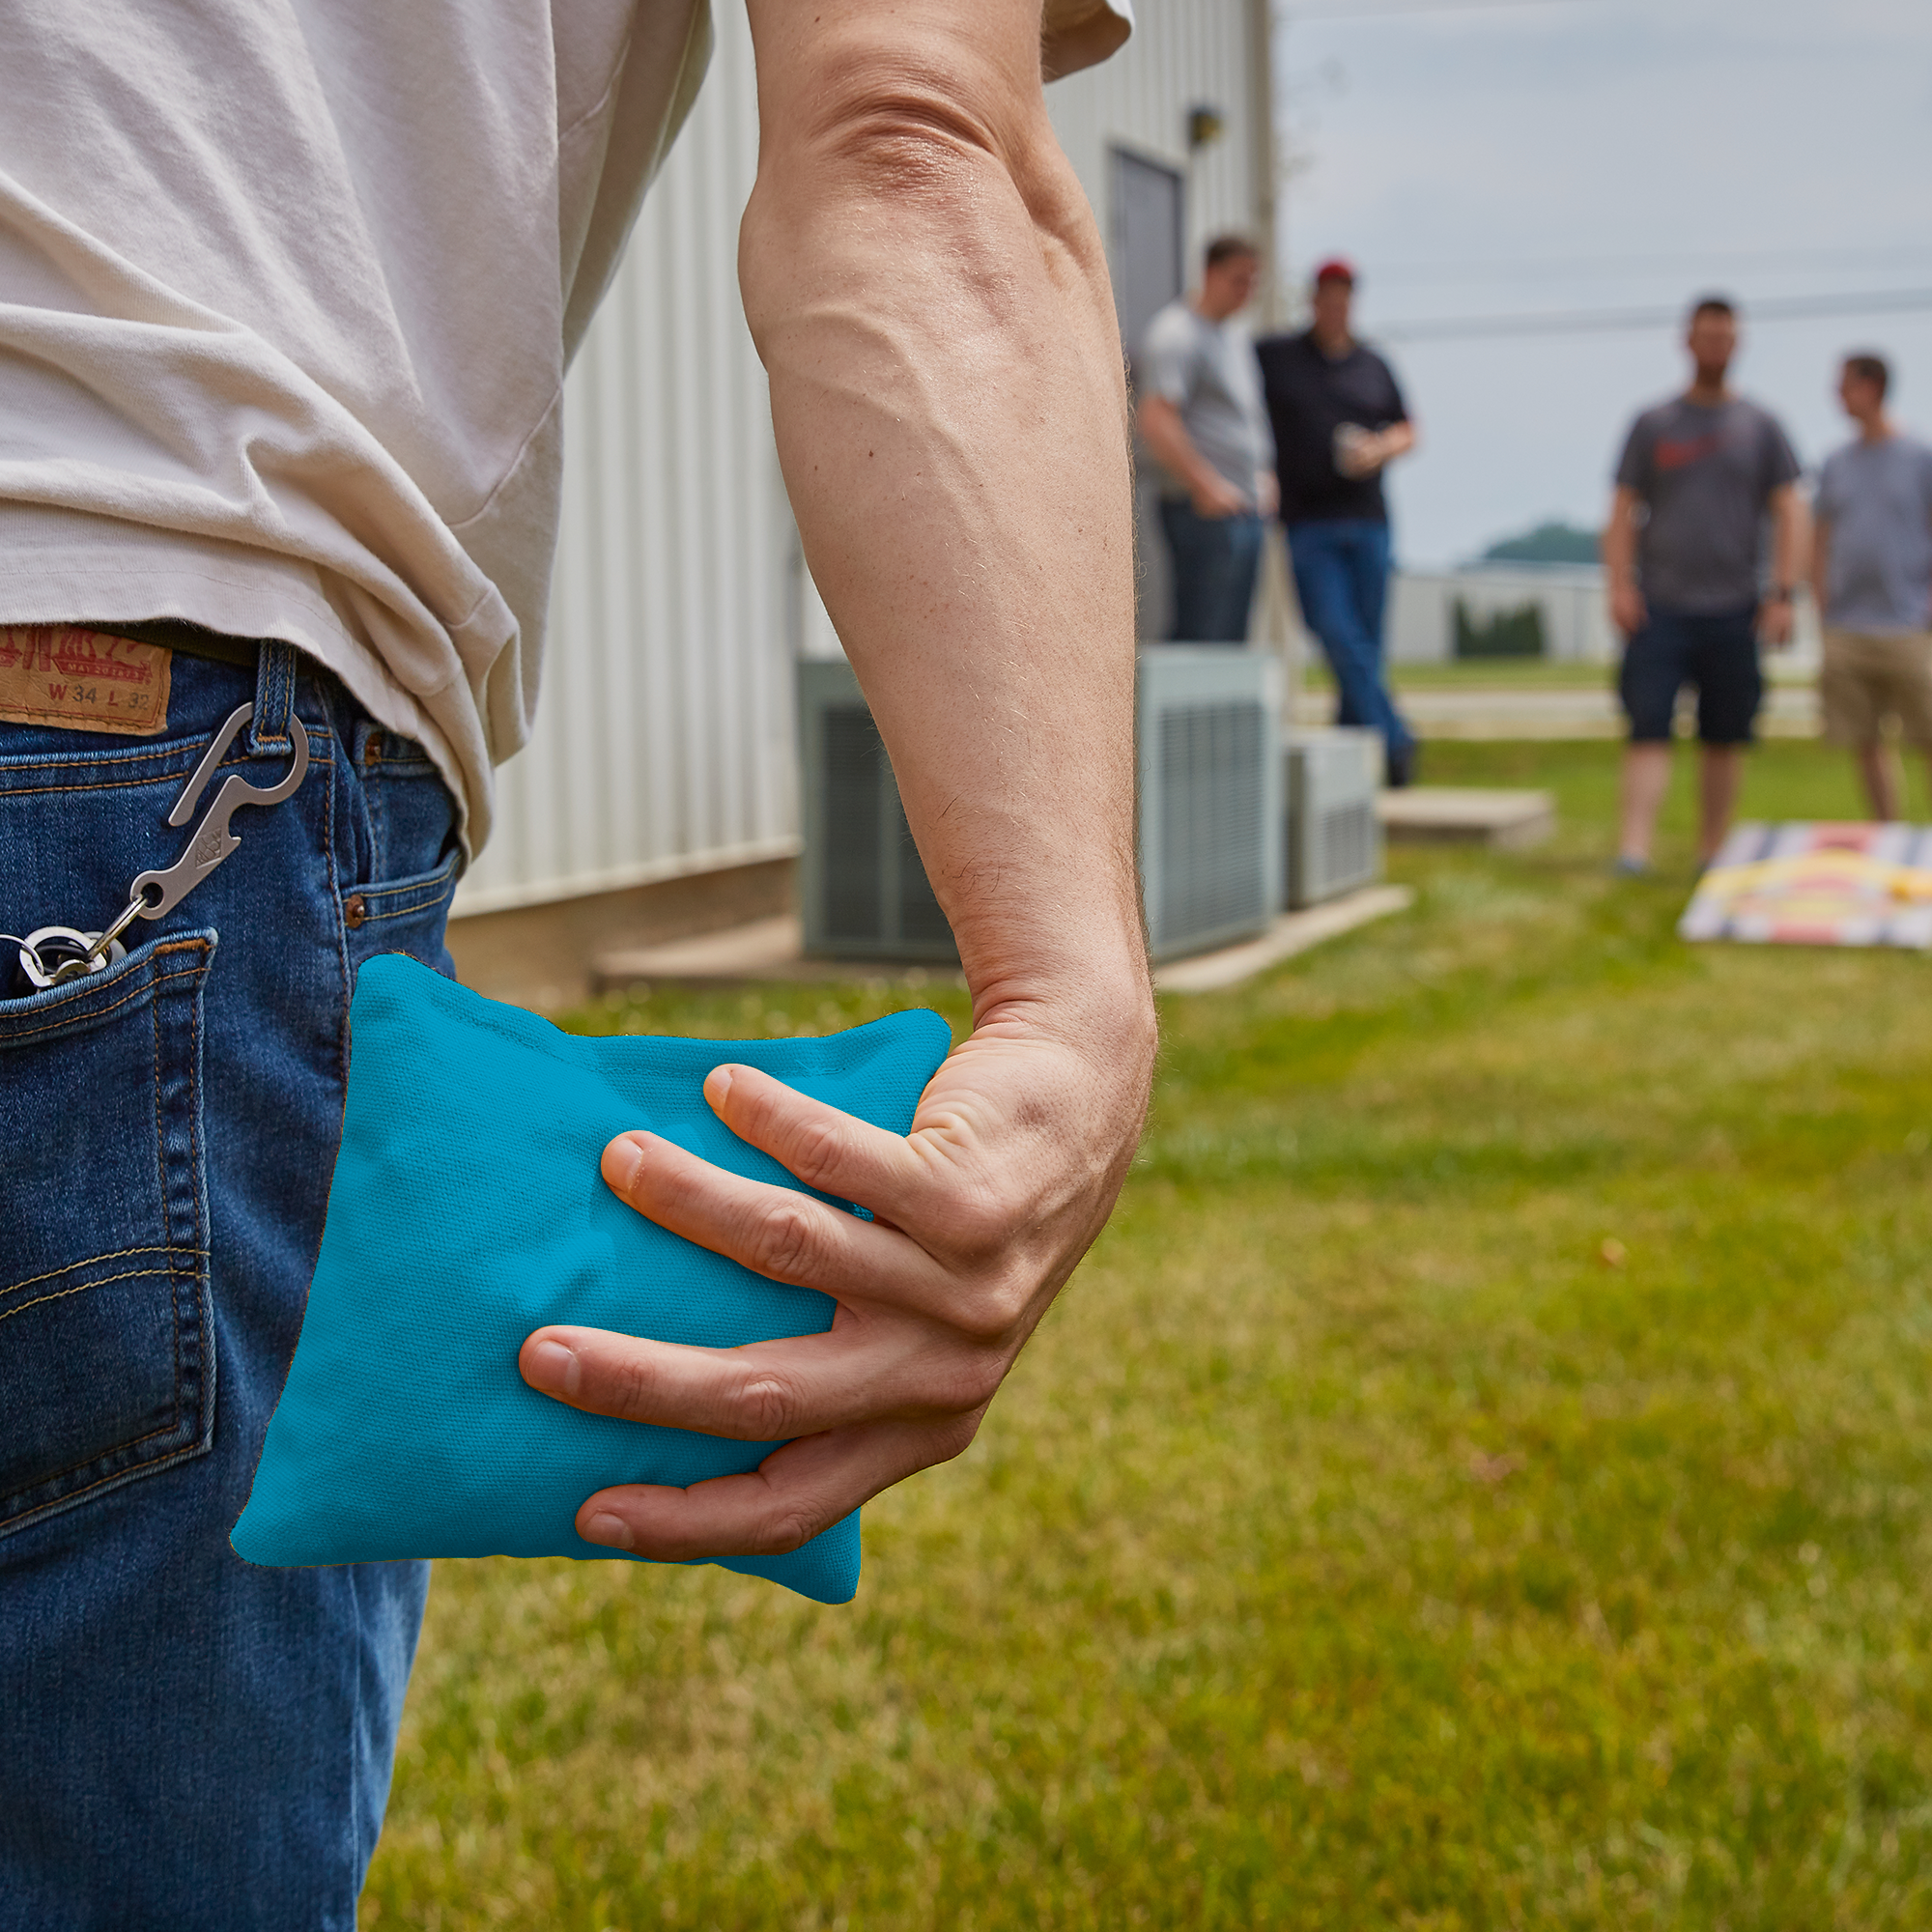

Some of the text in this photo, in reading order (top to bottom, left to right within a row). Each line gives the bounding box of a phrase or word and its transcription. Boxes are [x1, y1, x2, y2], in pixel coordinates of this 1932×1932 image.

[49, 683, 150, 710] W 34 L 32
